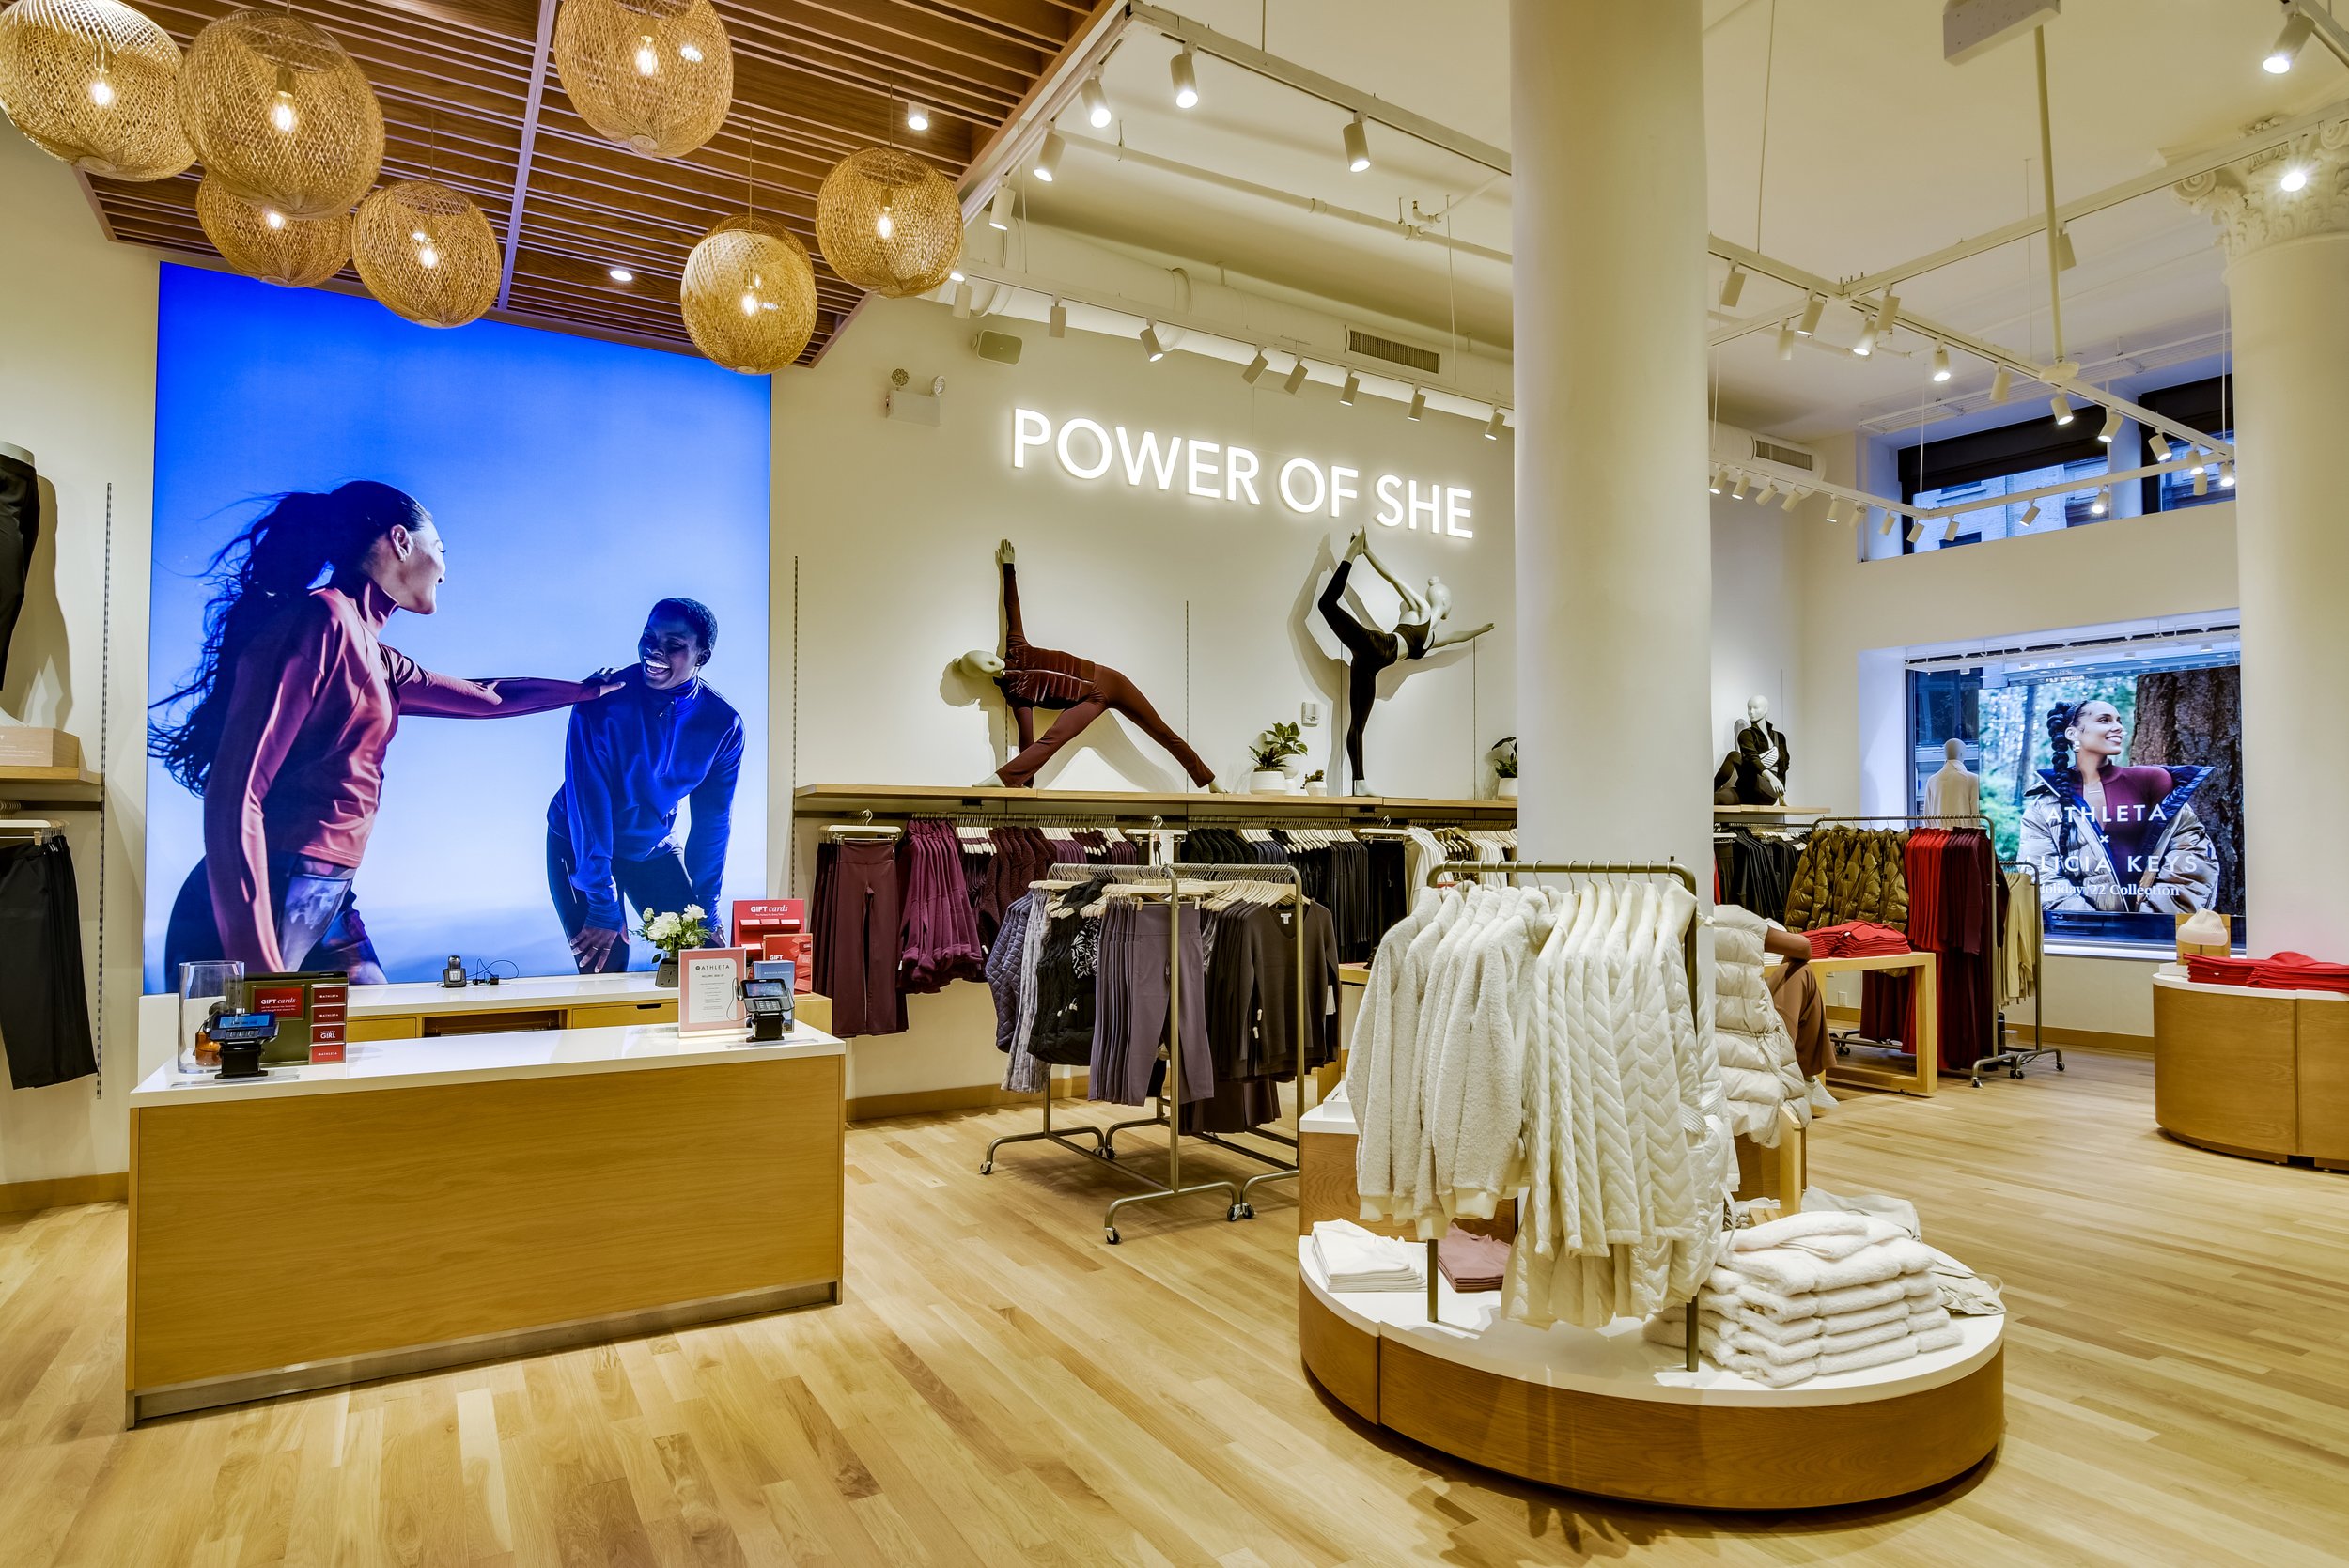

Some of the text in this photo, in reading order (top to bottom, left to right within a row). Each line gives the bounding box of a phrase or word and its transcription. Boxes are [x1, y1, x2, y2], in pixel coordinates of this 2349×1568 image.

[1013, 408, 1473, 539] POWER OF SHE
[2046, 803, 2168, 823] ATHLETA
[2127, 855, 2198, 873] KEYS
[2041, 883, 2083, 895] oliday
[2110, 883, 2180, 896] Collection
[768, 904, 788, 912] cards
